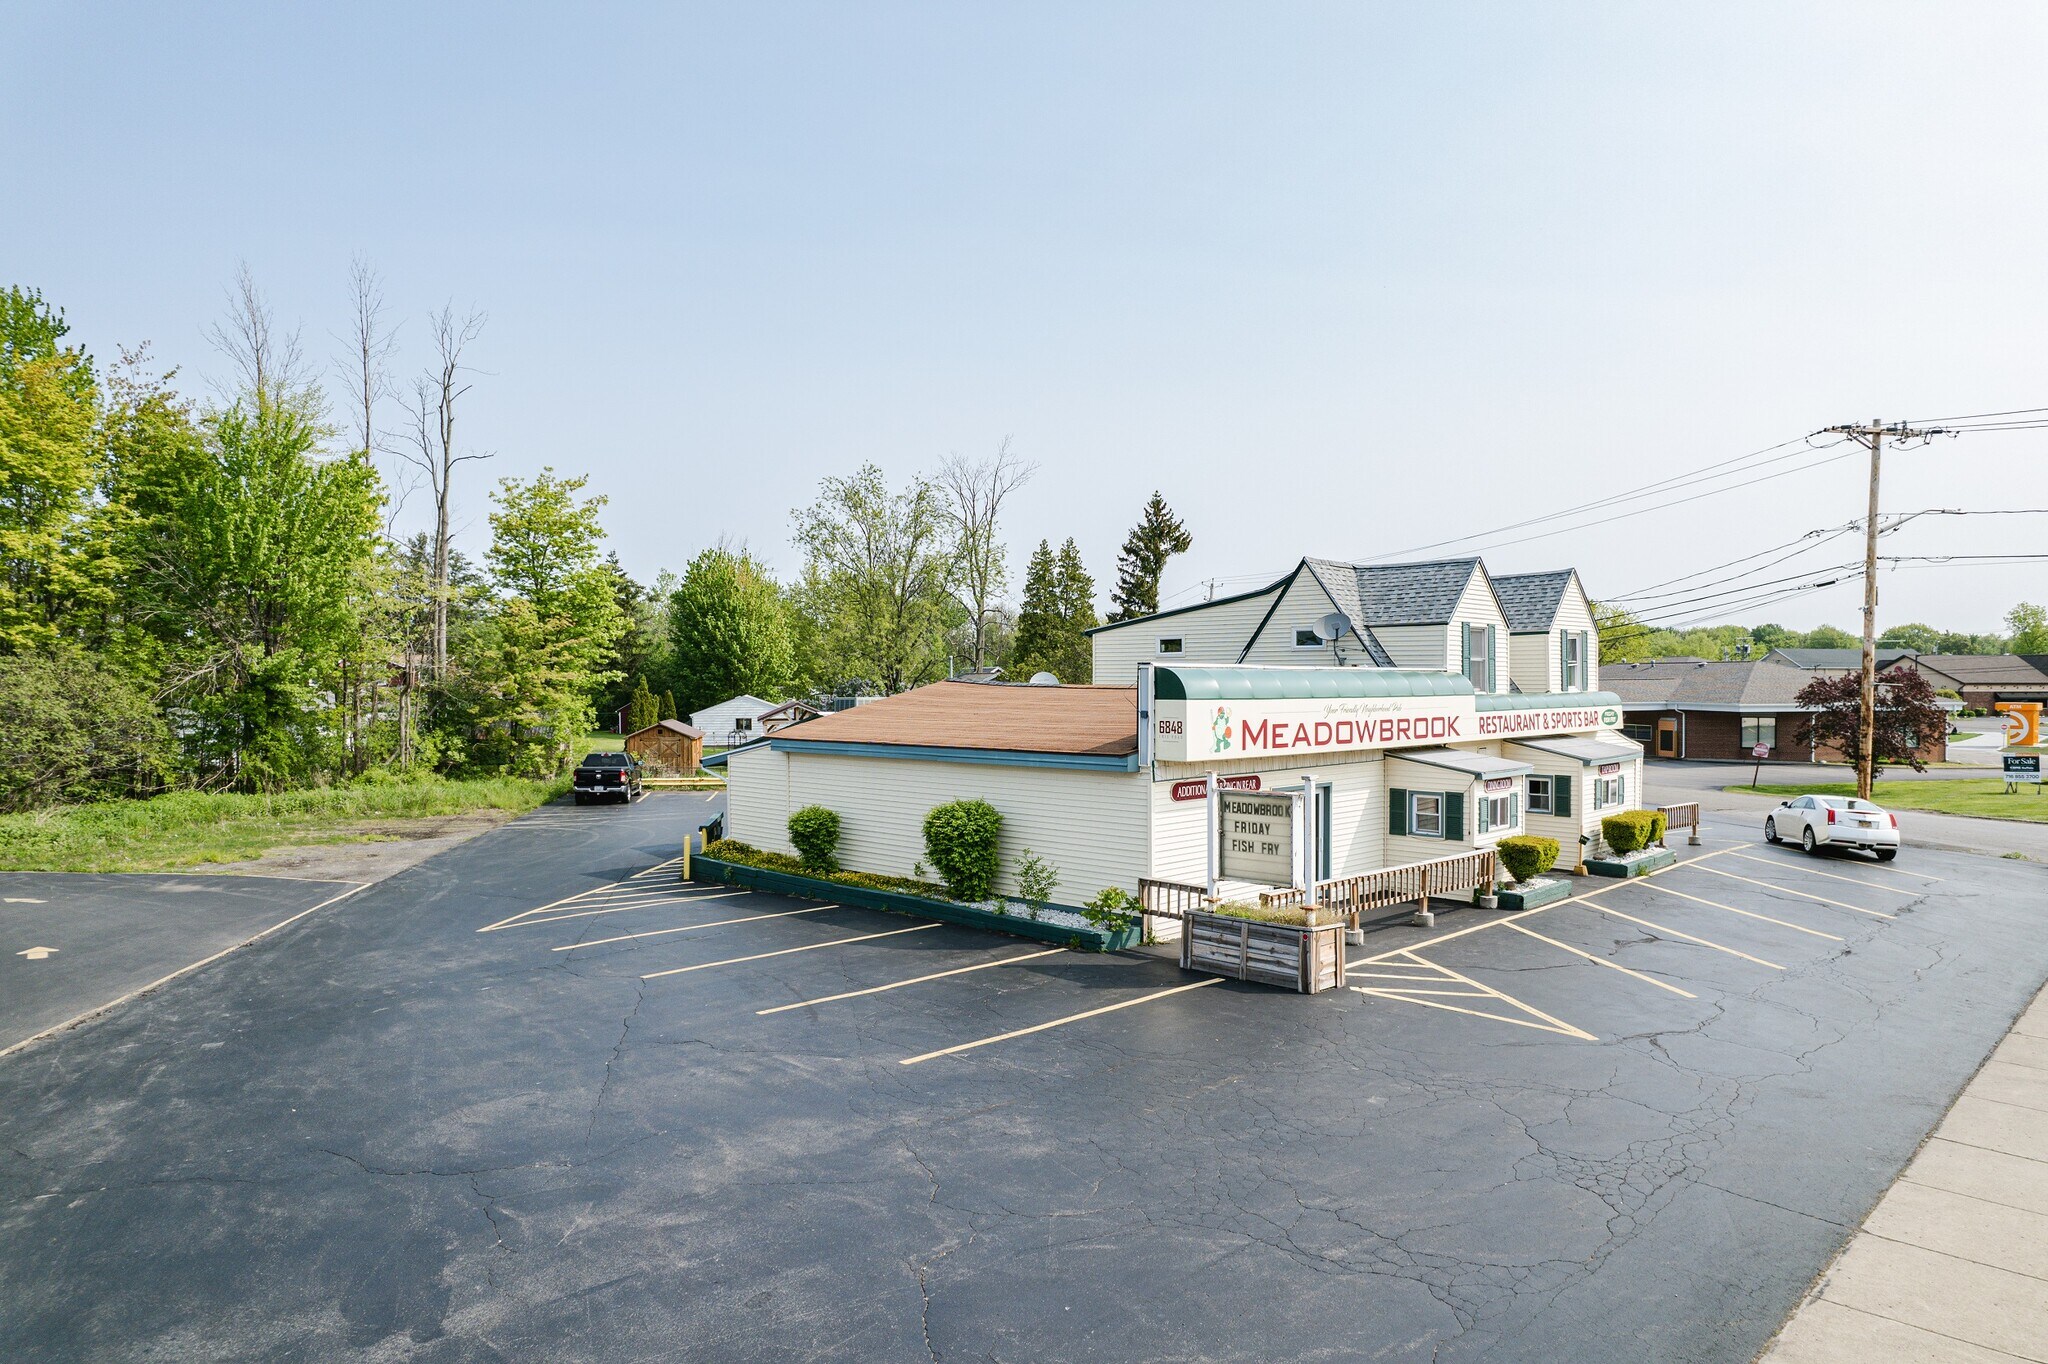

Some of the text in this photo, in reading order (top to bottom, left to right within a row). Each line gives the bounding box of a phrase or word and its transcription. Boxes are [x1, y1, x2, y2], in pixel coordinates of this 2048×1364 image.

[1159, 720, 1183, 734] 6848
[1478, 710, 1600, 734] RESTAURANT & SPORTS BAR
[1241, 715, 1461, 751] MEADOWBROOK
[2007, 757, 2036, 765] For Sale
[1177, 784, 1208, 798] ADDITION
[1242, 779, 1257, 790] REAR
[1224, 801, 1291, 817] MEADOWBROOK
[1234, 821, 1271, 836] FRIDAY
[1232, 840, 1280, 856] FISH FRY
